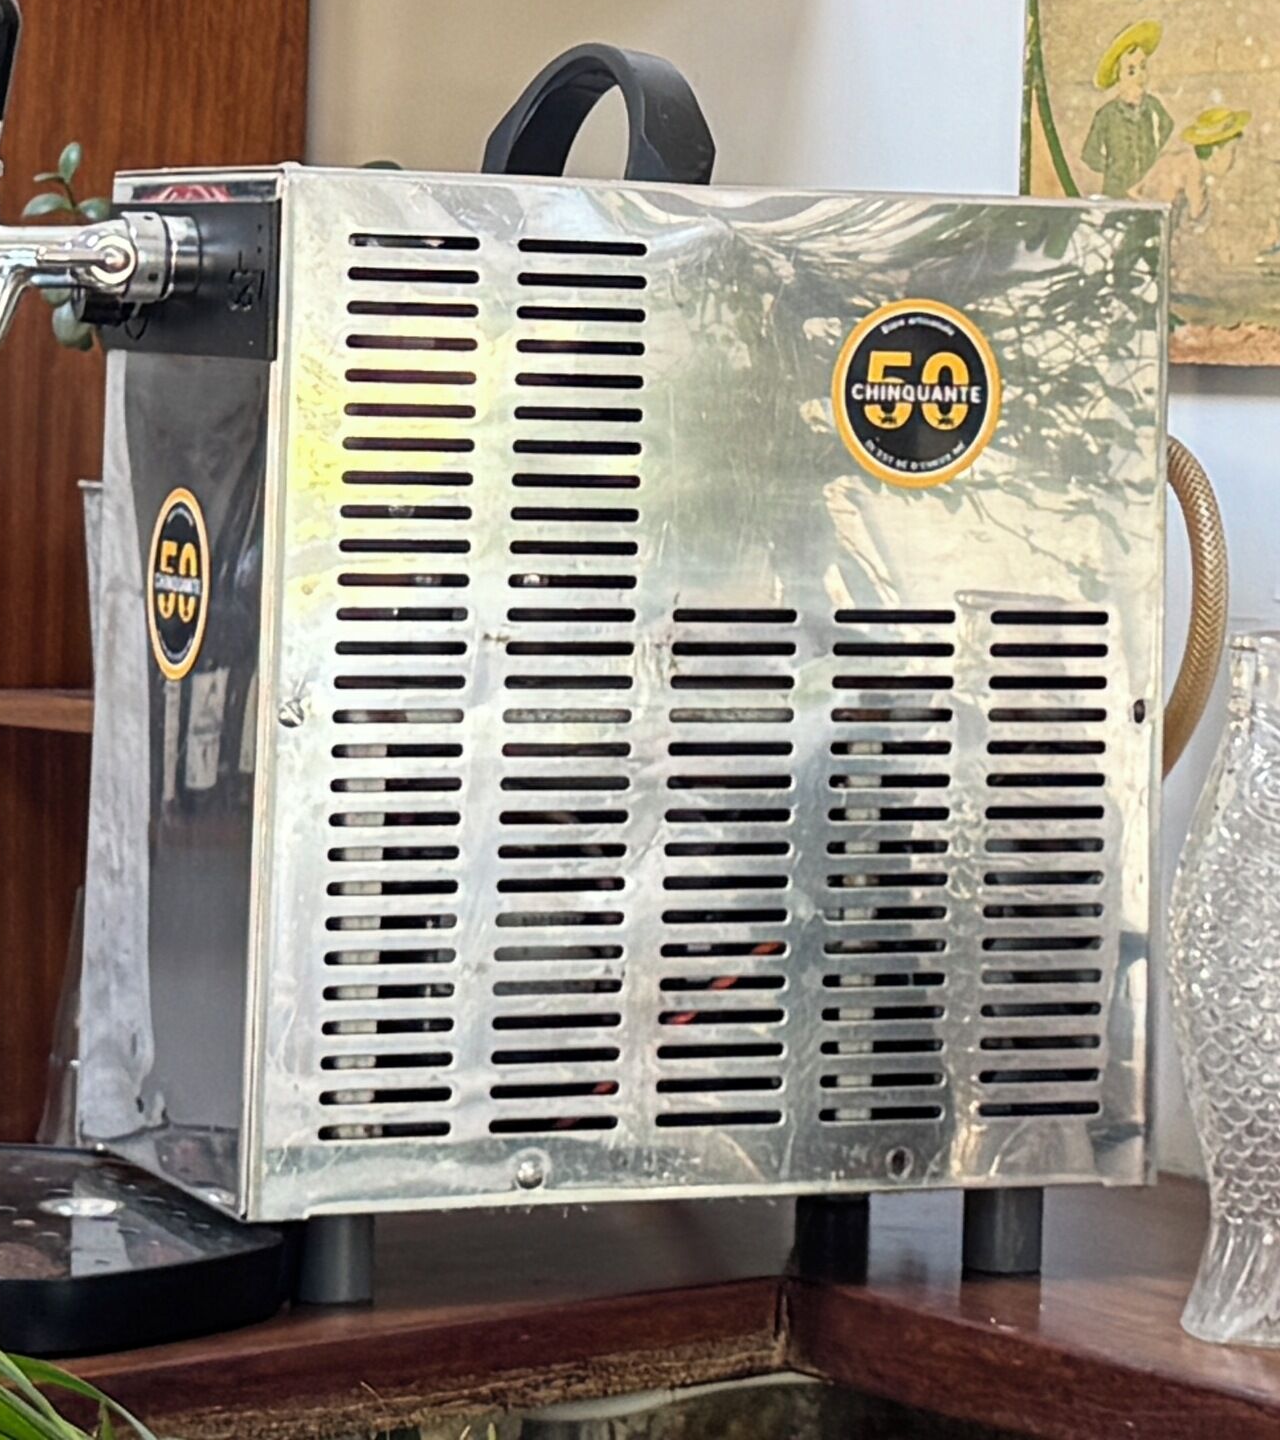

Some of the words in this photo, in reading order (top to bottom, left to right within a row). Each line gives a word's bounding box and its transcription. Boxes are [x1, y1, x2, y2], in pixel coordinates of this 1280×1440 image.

[851, 383, 982, 404] CHINQUANTE
[864, 351, 969, 431] 50
[158, 539, 198, 623] 50
